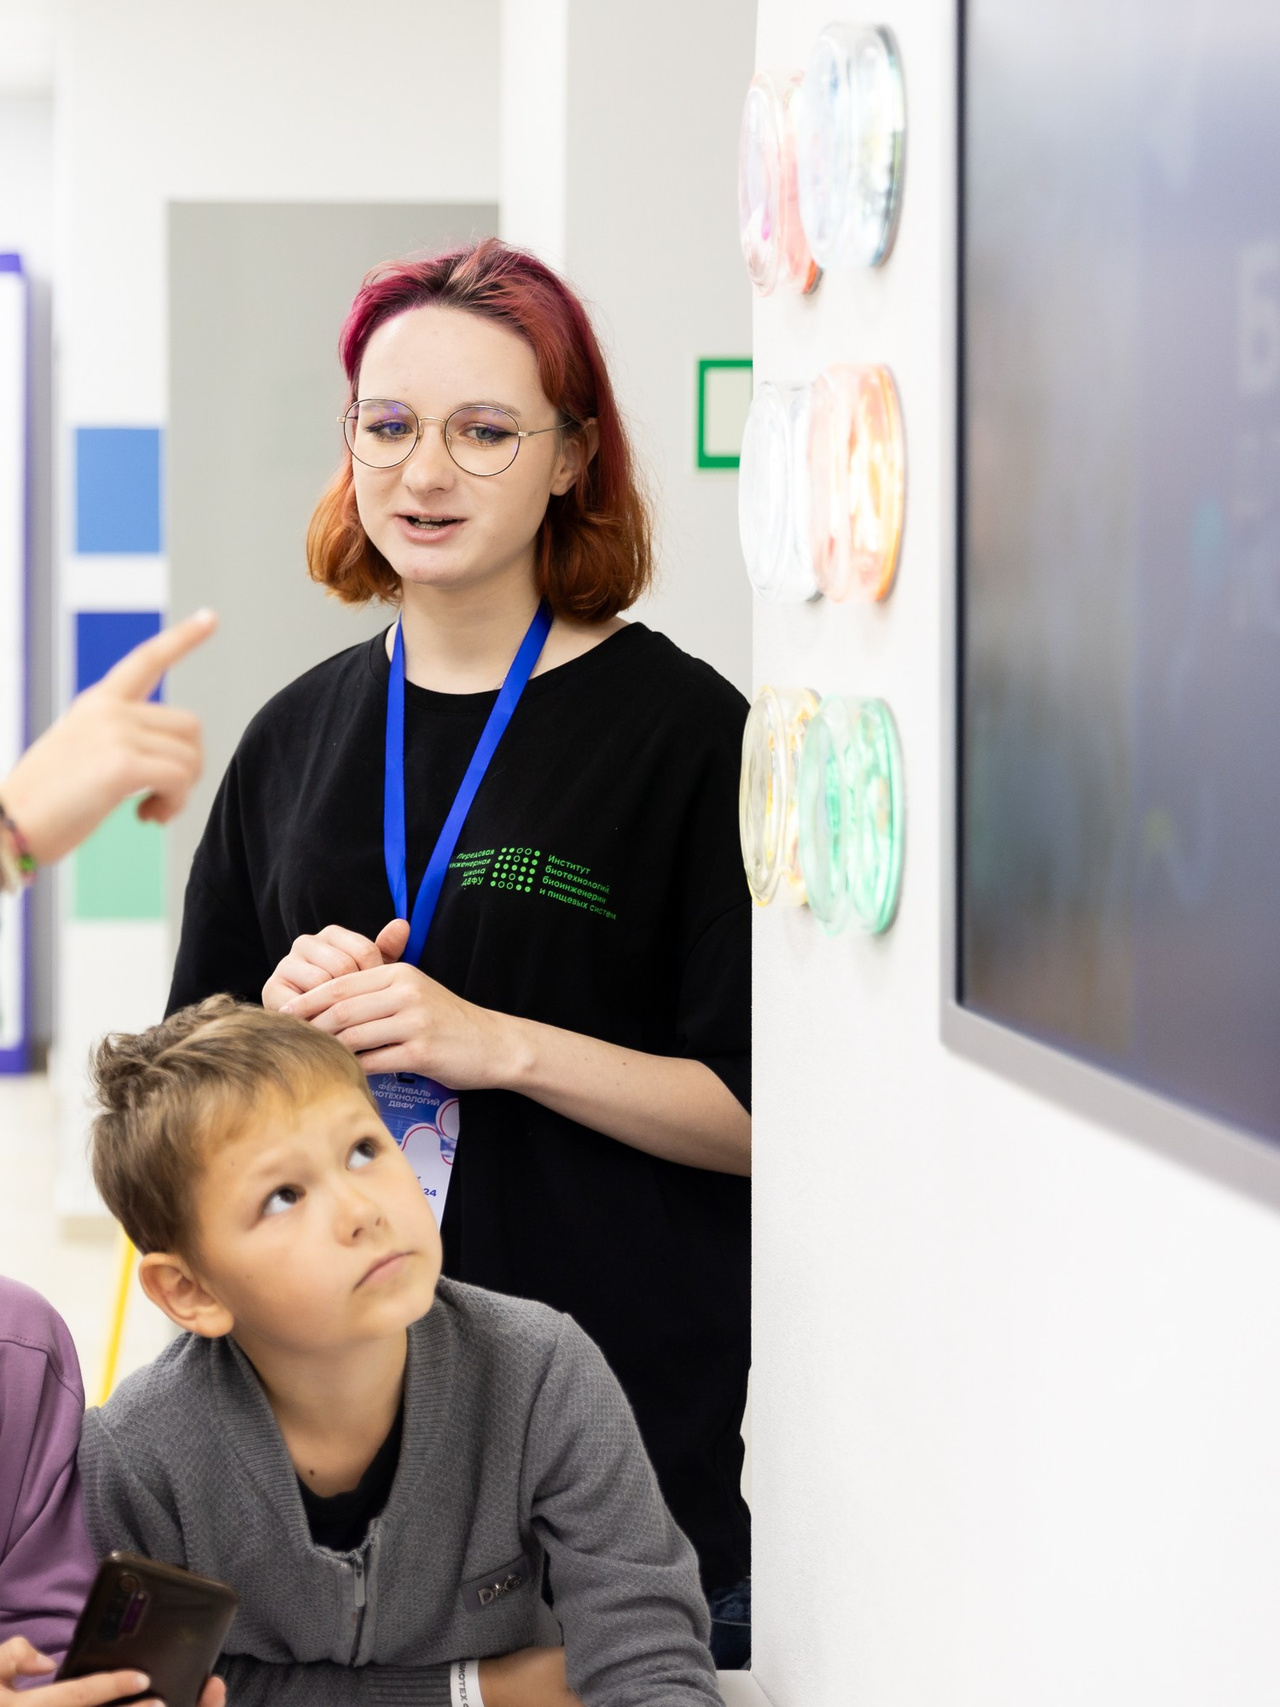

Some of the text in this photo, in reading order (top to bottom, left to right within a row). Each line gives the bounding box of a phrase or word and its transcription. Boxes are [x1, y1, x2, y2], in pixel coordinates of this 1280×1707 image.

[548, 854, 591, 874] Институт
[542, 875, 607, 904] биоинженерии
[547, 890, 588, 909] пищевых
[589, 904, 617, 920] систем
[372, 1090, 441, 1106] ИОТЕХНОЛОГИЙ
[378, 1084, 431, 1097] ФЕСТИВАЛЬ
[388, 1100, 415, 1109] ДВФУ
